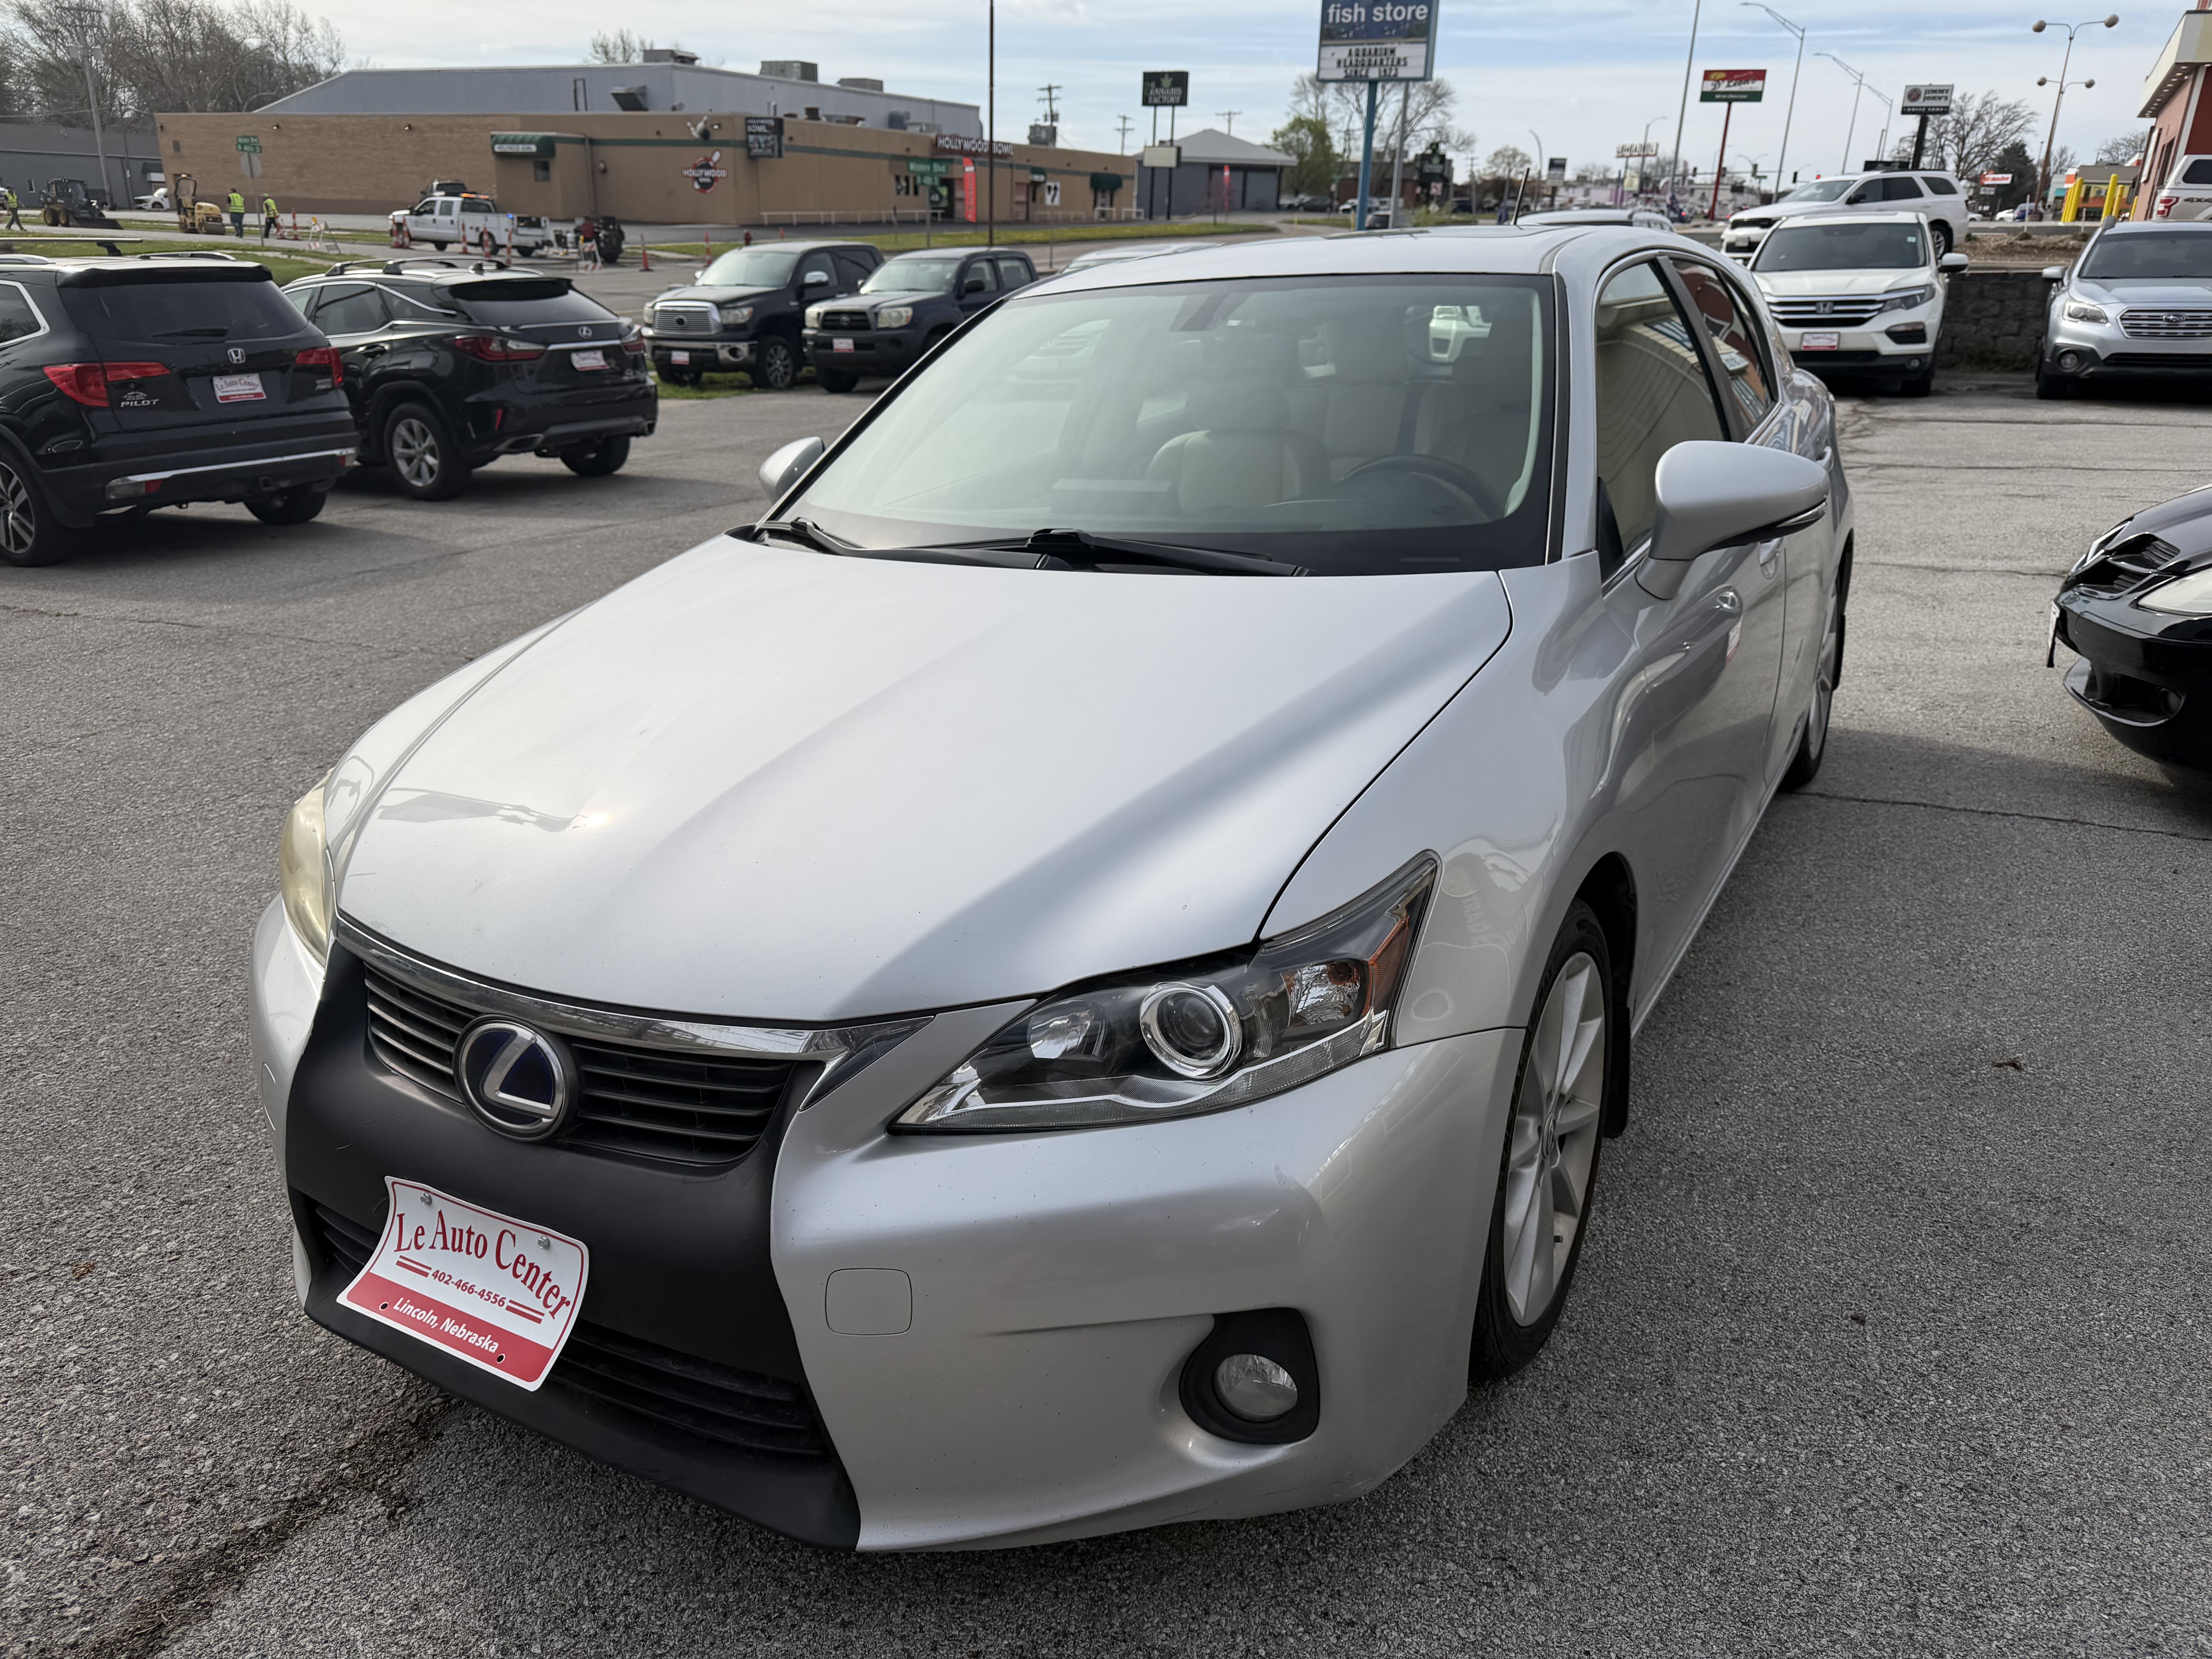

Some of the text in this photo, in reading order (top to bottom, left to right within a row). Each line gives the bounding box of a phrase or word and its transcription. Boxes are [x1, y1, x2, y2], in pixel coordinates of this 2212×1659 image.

[1327, 2, 1429, 23] fish store
[1347, 47, 1396, 57] AQUARIUM
[1336, 57, 1408, 68] HEADQUARTERS
[1343, 67, 1369, 78] SINCE
[937, 136, 988, 152] HOLLYWOOD
[682, 168, 727, 177] HOLLYWOOD
[223, 379, 238, 388] Auto
[121, 398, 159, 407] PILOT
[393, 1209, 571, 1320] Le Auto Center
[431, 1269, 507, 1307] 402-466-4556
[393, 1297, 500, 1354] Lincoln, Nebraska
